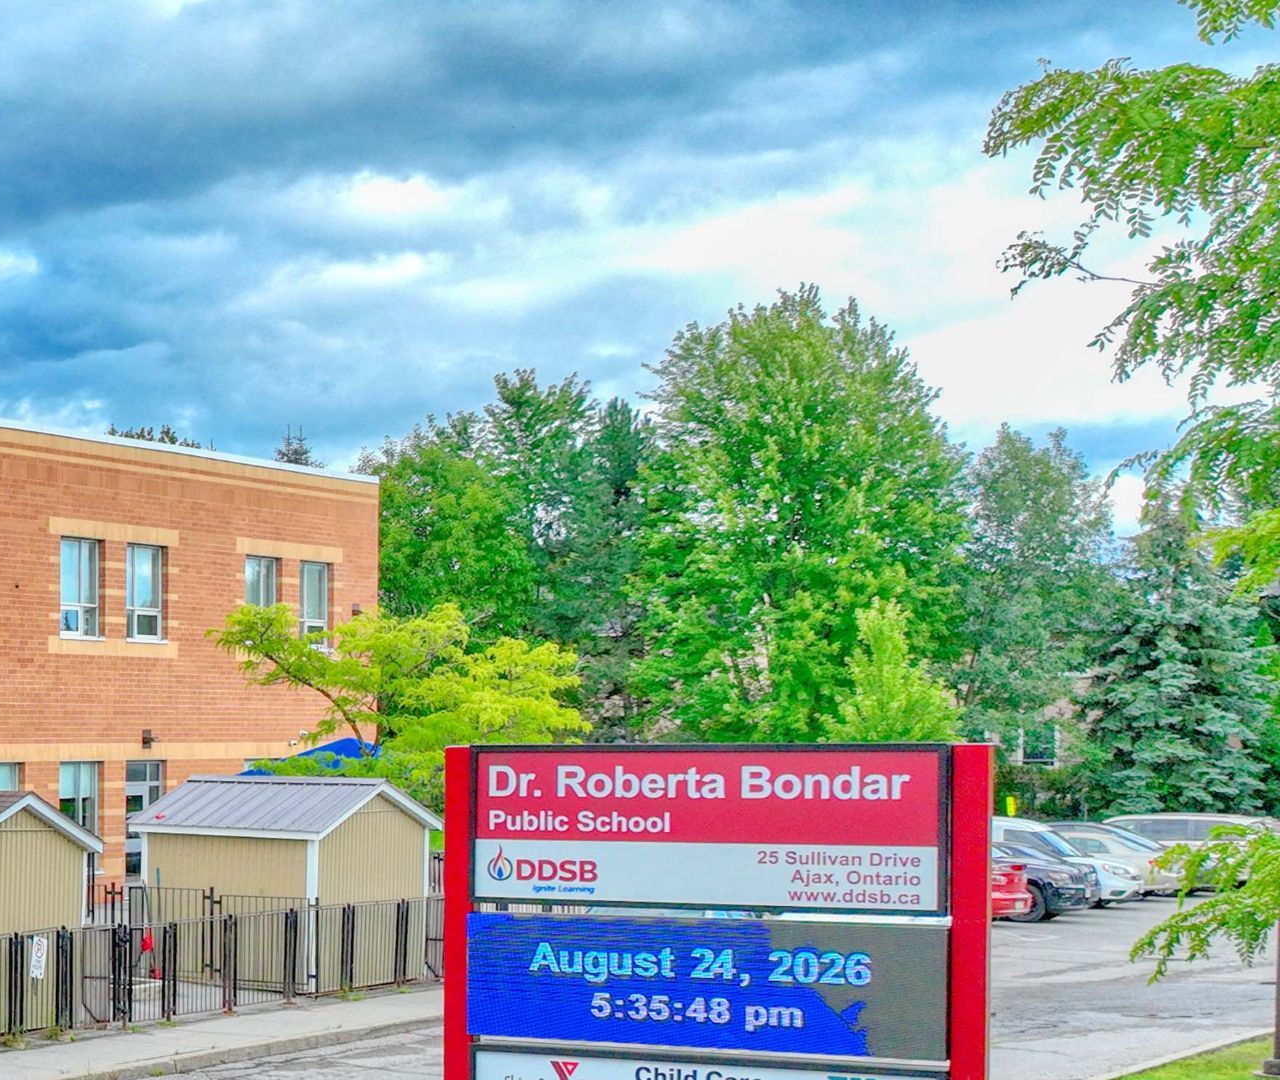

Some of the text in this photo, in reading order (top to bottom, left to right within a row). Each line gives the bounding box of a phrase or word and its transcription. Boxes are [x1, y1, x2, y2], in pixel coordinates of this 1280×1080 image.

[488, 765, 911, 800] Dr. Roberta Bondar
[489, 810, 671, 833] Public School
[516, 859, 599, 882] DDSB
[757, 851, 921, 868] 25 Sullivan Drive
[558, 885, 595, 894] Learning
[791, 869, 921, 887] Ajax, Ontario
[788, 888, 921, 905] www.ddsb.ca
[528, 942, 873, 987] August 24, 2026
[589, 992, 806, 1033] 5:35:48 pm
